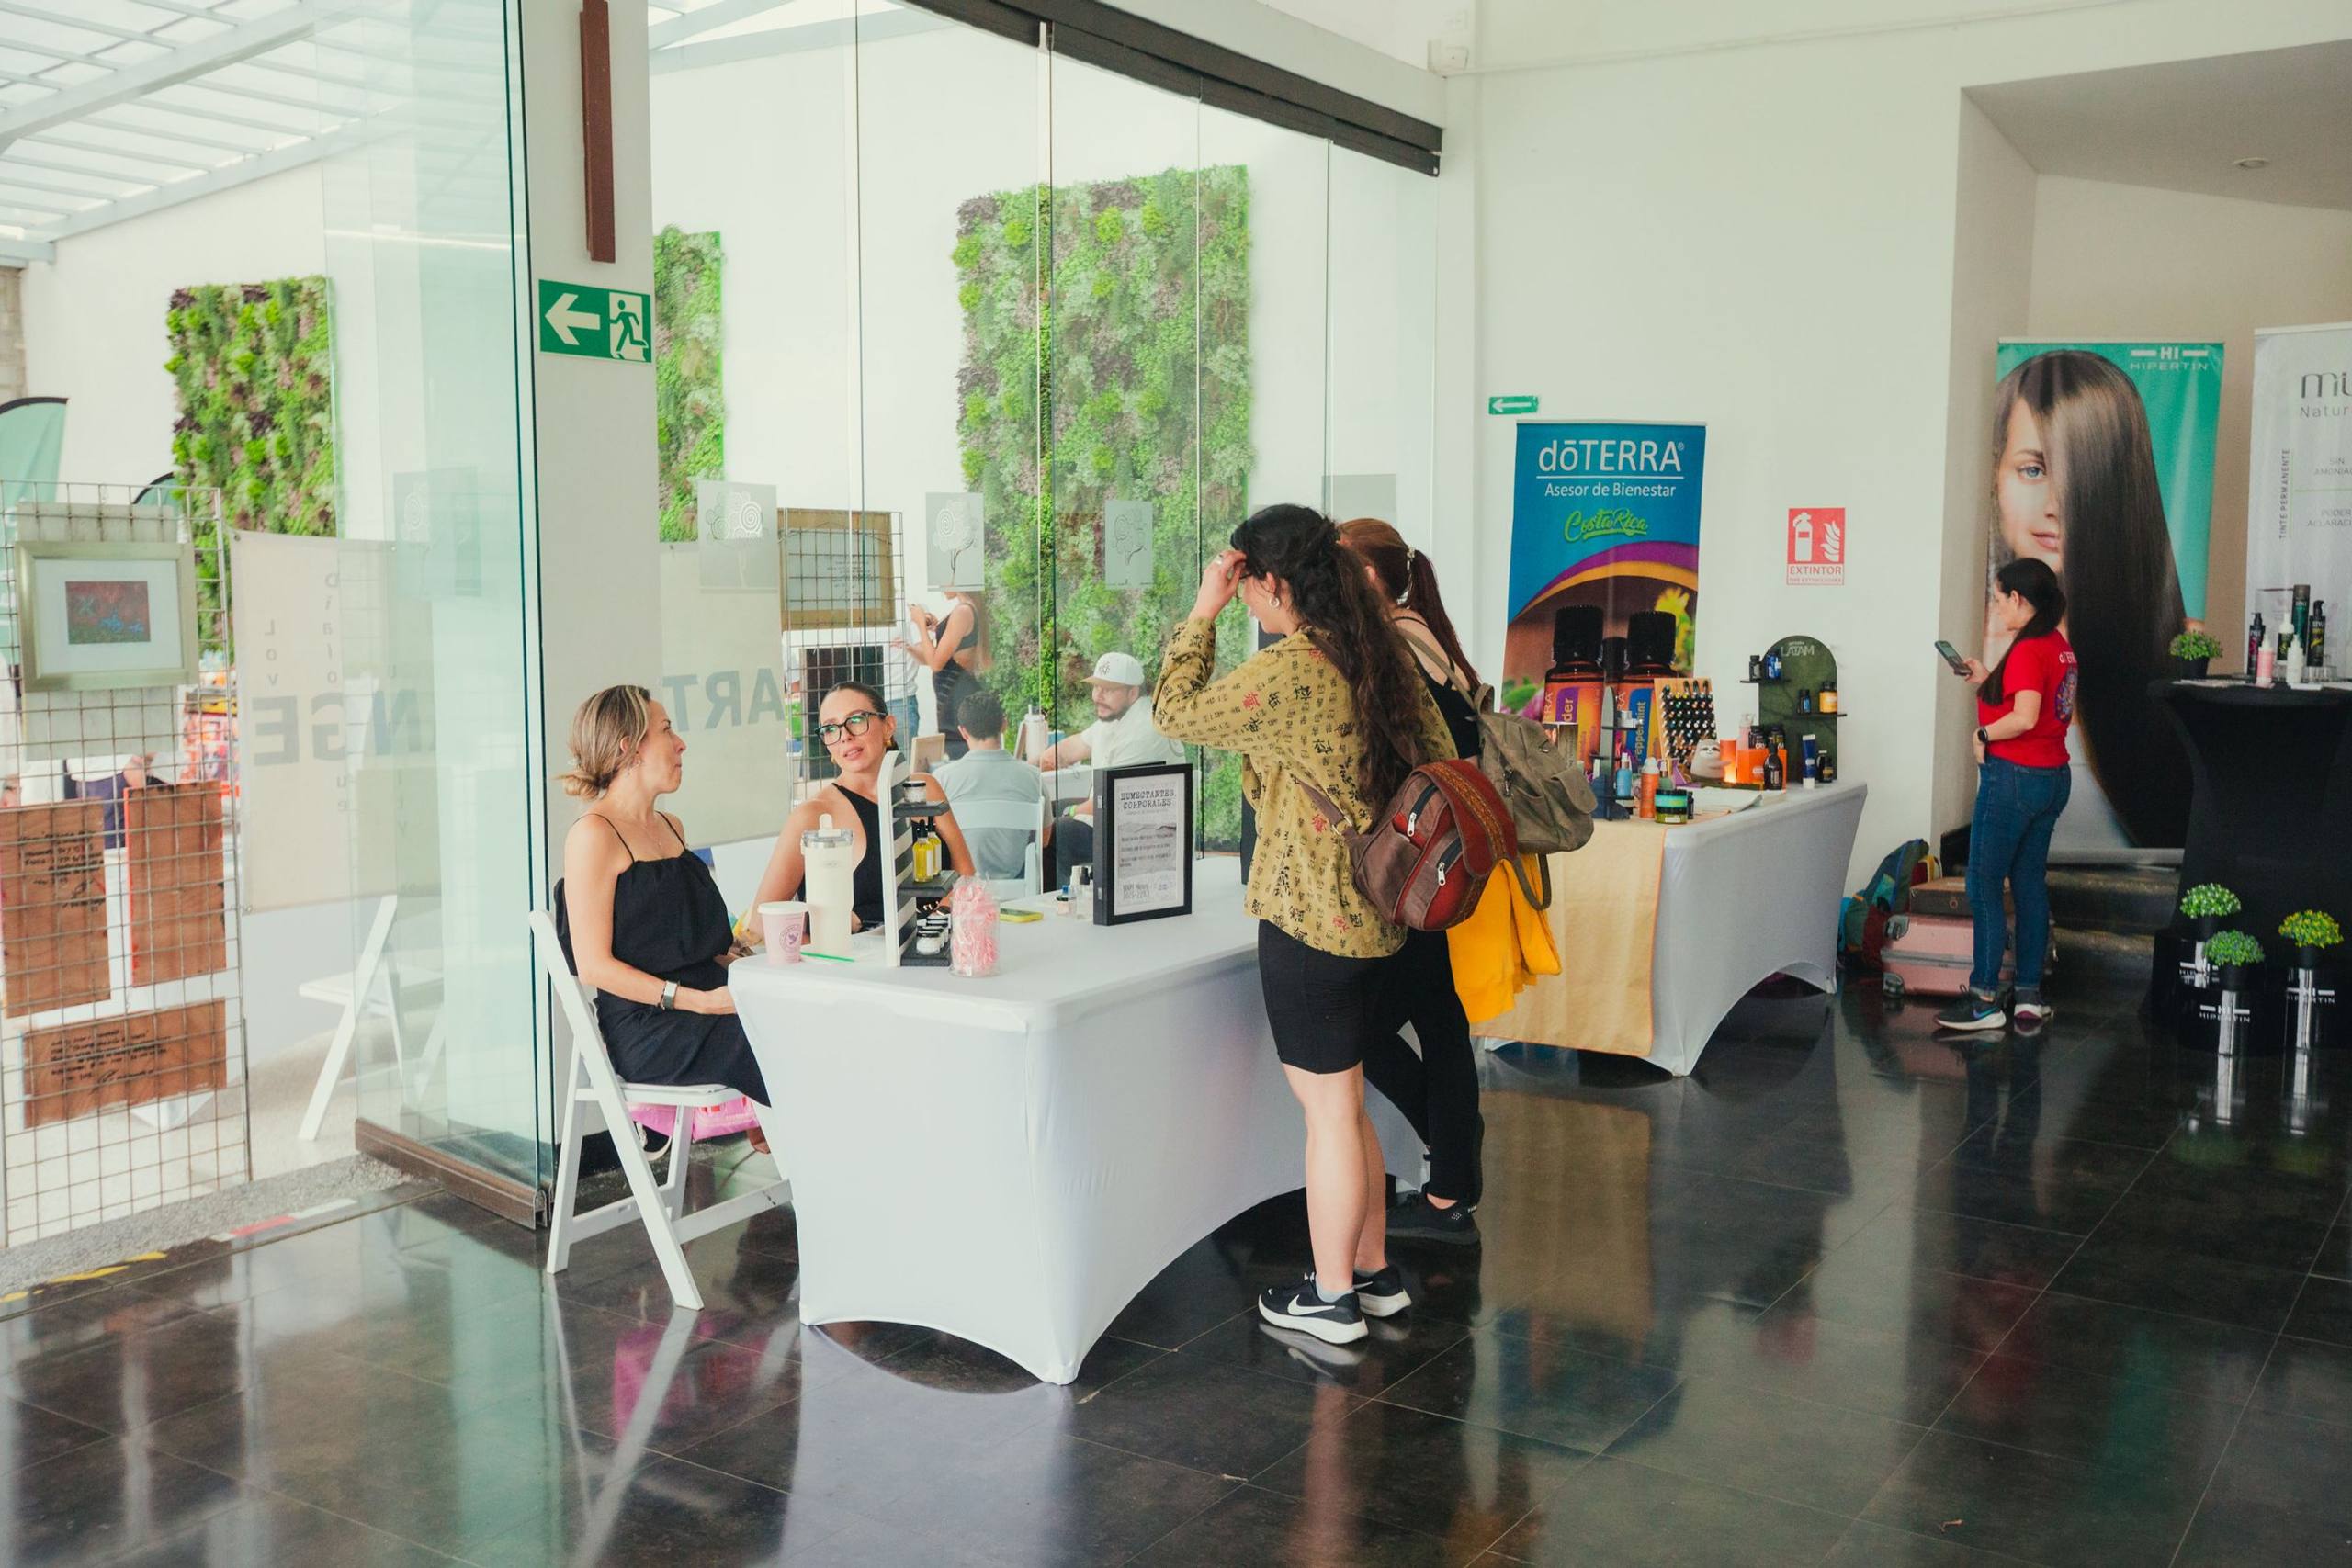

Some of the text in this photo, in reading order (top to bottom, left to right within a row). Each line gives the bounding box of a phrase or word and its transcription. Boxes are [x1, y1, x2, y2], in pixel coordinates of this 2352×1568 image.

[2161, 346, 2178, 360] HI
[2131, 361, 2208, 371] HIPERTIN
[2300, 404, 2352, 418] Natur
[1544, 482, 1676, 498] Asesor de Bienestar
[2278, 448, 2290, 539] TINTE PERMANENTE
[1564, 507, 1648, 543] Costa Rica
[1790, 565, 1842, 575] EXTINTOR
[1780, 645, 1815, 658] LATAM
[1123, 799, 1171, 810] CORPORALES
[2199, 1012, 2250, 1023] HIPTIN
